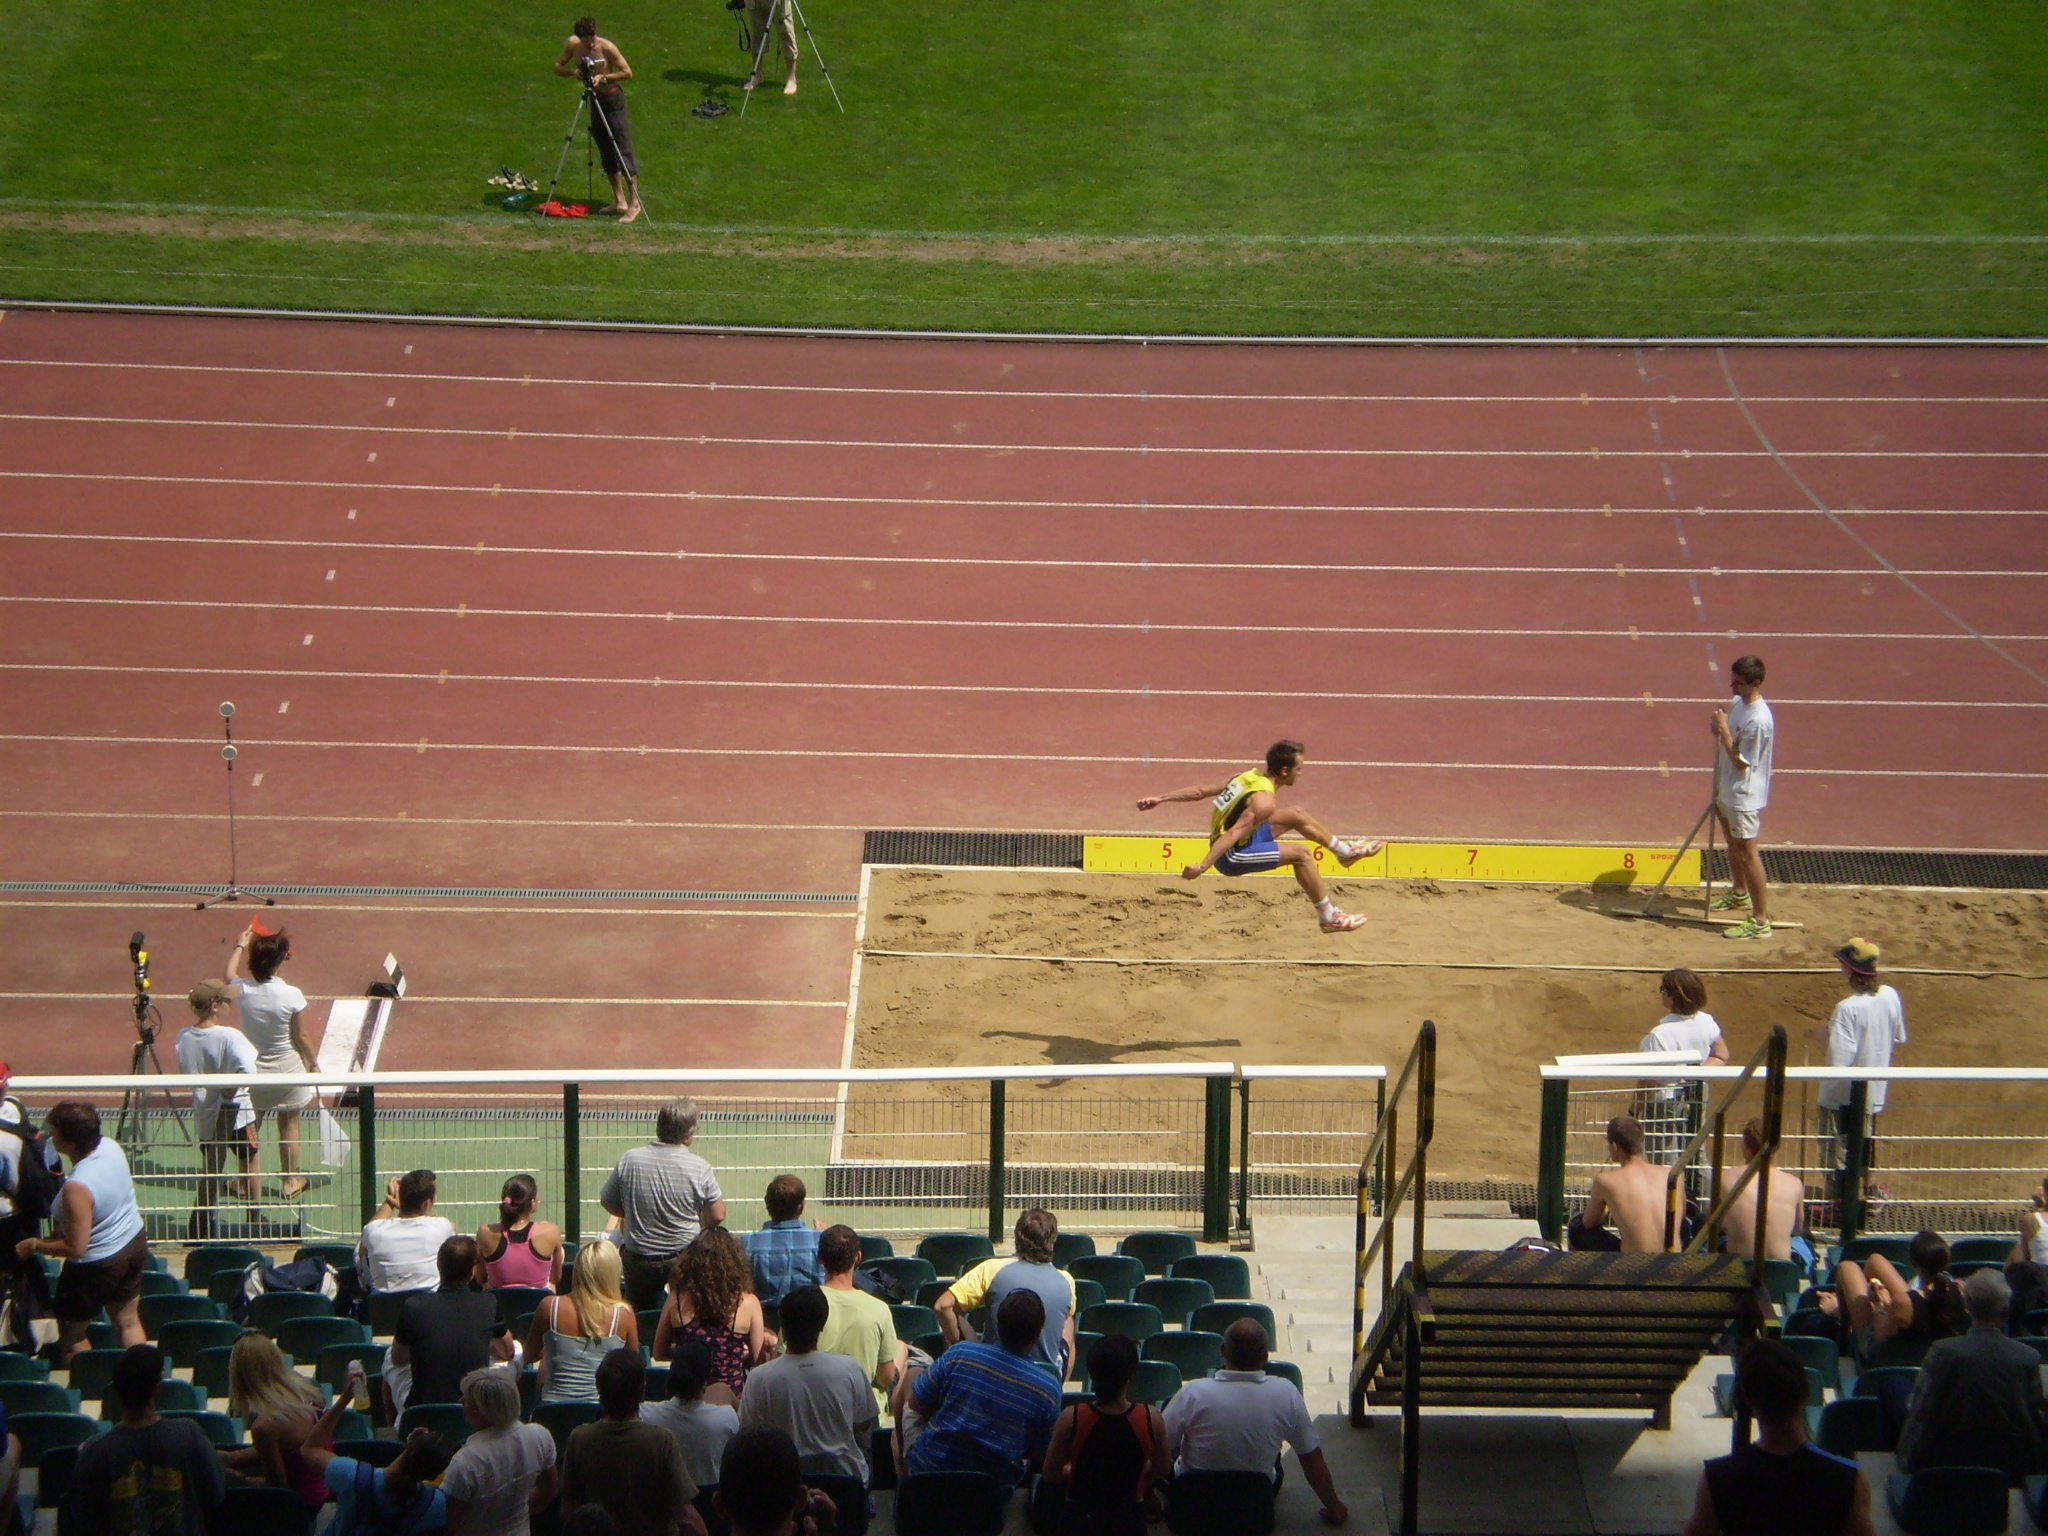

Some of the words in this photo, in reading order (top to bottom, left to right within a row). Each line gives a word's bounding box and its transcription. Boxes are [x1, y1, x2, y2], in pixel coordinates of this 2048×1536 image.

[1162, 843, 1172, 859] 5
[1313, 846, 1324, 862] 6
[1467, 849, 1478, 865] 7
[1624, 853, 1635, 869] 8
